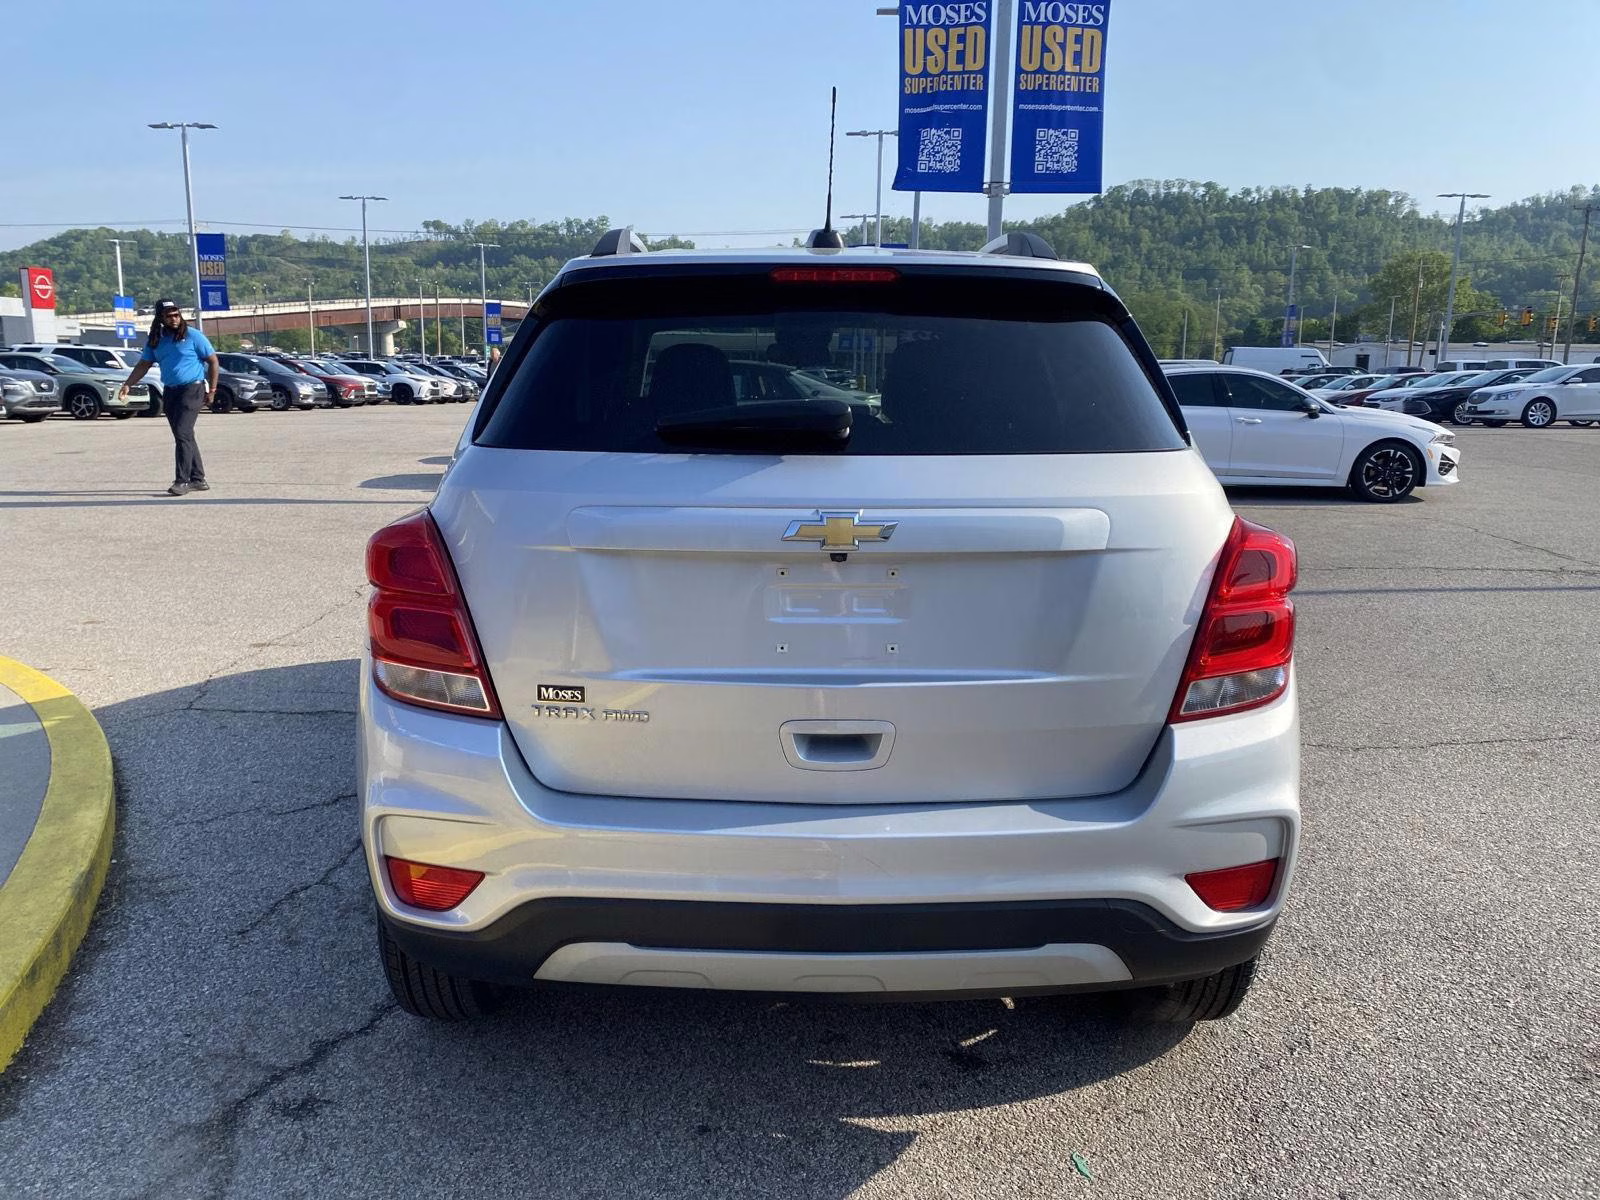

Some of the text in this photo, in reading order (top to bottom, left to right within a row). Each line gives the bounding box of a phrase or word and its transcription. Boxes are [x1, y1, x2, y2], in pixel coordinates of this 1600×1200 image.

[904, 2, 987, 26] MOSES
[1023, 1, 1105, 26] MOSES
[904, 25, 987, 76] USED
[1020, 25, 1103, 74] USED
[904, 74, 984, 95] SUPERCENTER
[1019, 73, 1100, 94] SUPERCENTER
[904, 103, 983, 114] mosesupercenter.com
[200, 262, 225, 276] USED
[540, 687, 582, 701] MOSES
[531, 704, 650, 723] TRAX AWD
